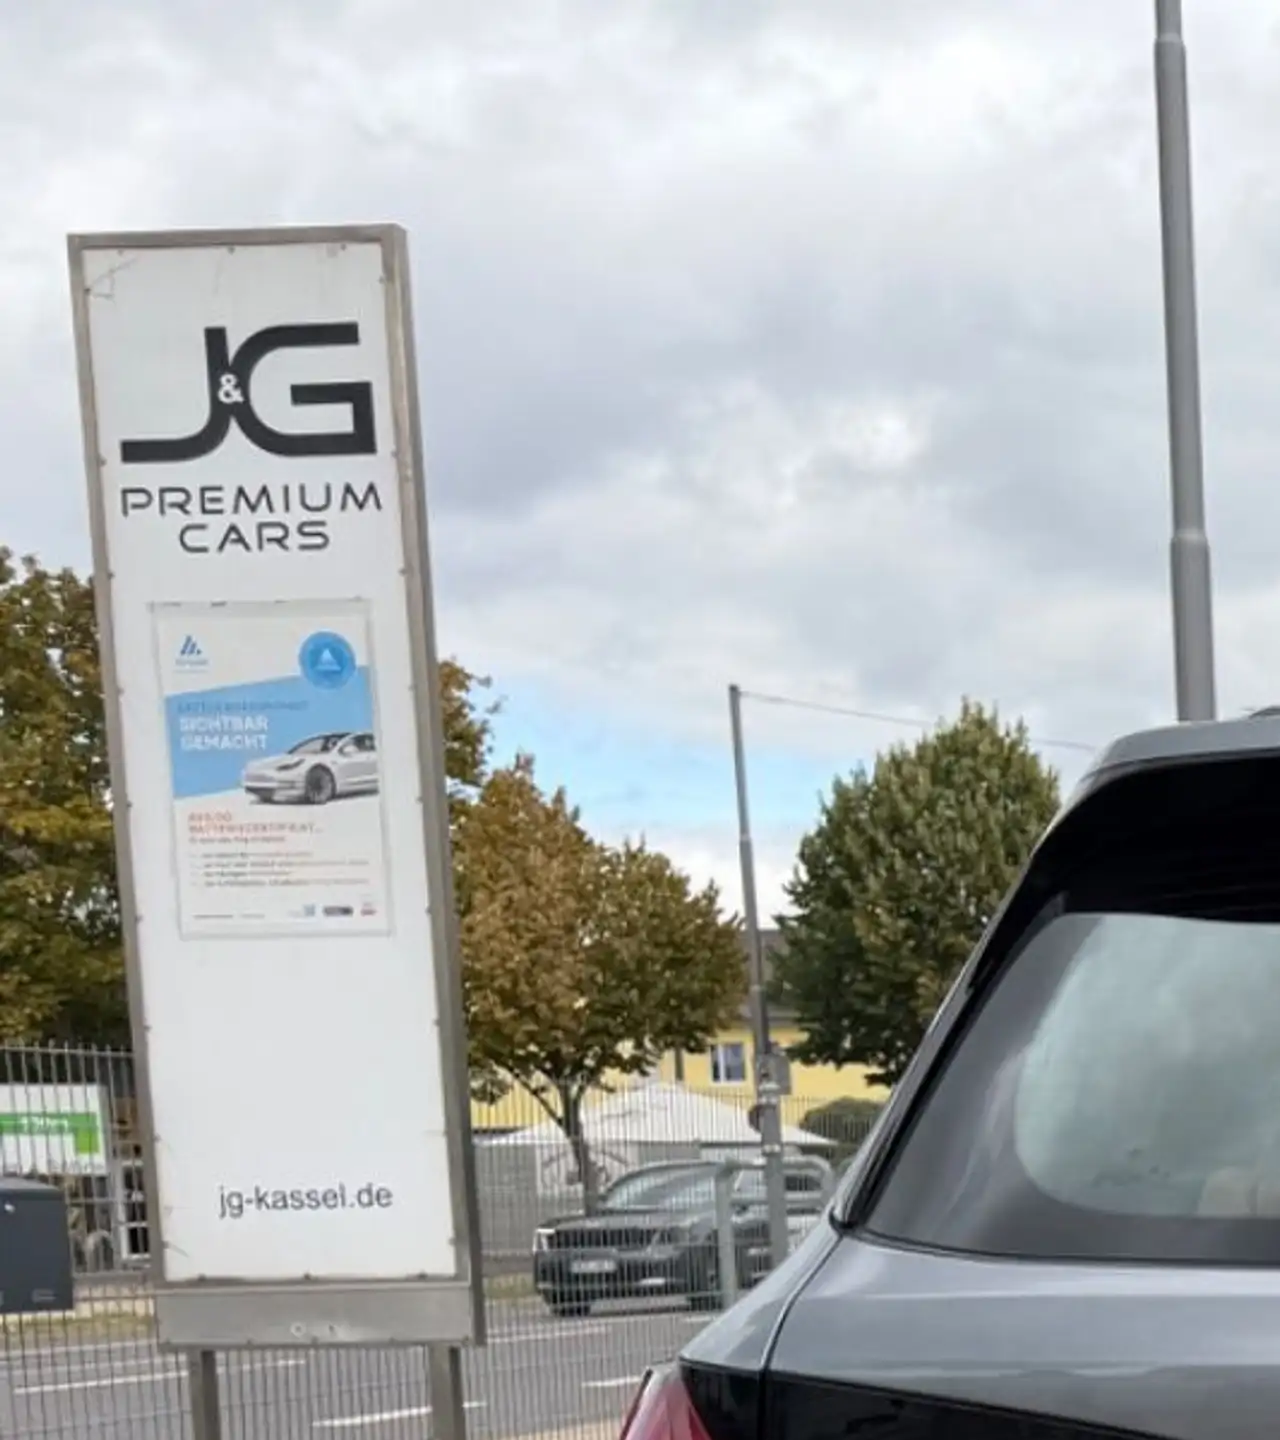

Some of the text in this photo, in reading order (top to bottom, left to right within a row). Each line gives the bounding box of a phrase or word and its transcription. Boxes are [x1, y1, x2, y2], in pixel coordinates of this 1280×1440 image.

[120, 322, 377, 463] J&G
[121, 482, 382, 516] PREMIUM
[179, 521, 330, 553] CARS
[219, 1183, 393, 1218] jg-kassel.de
